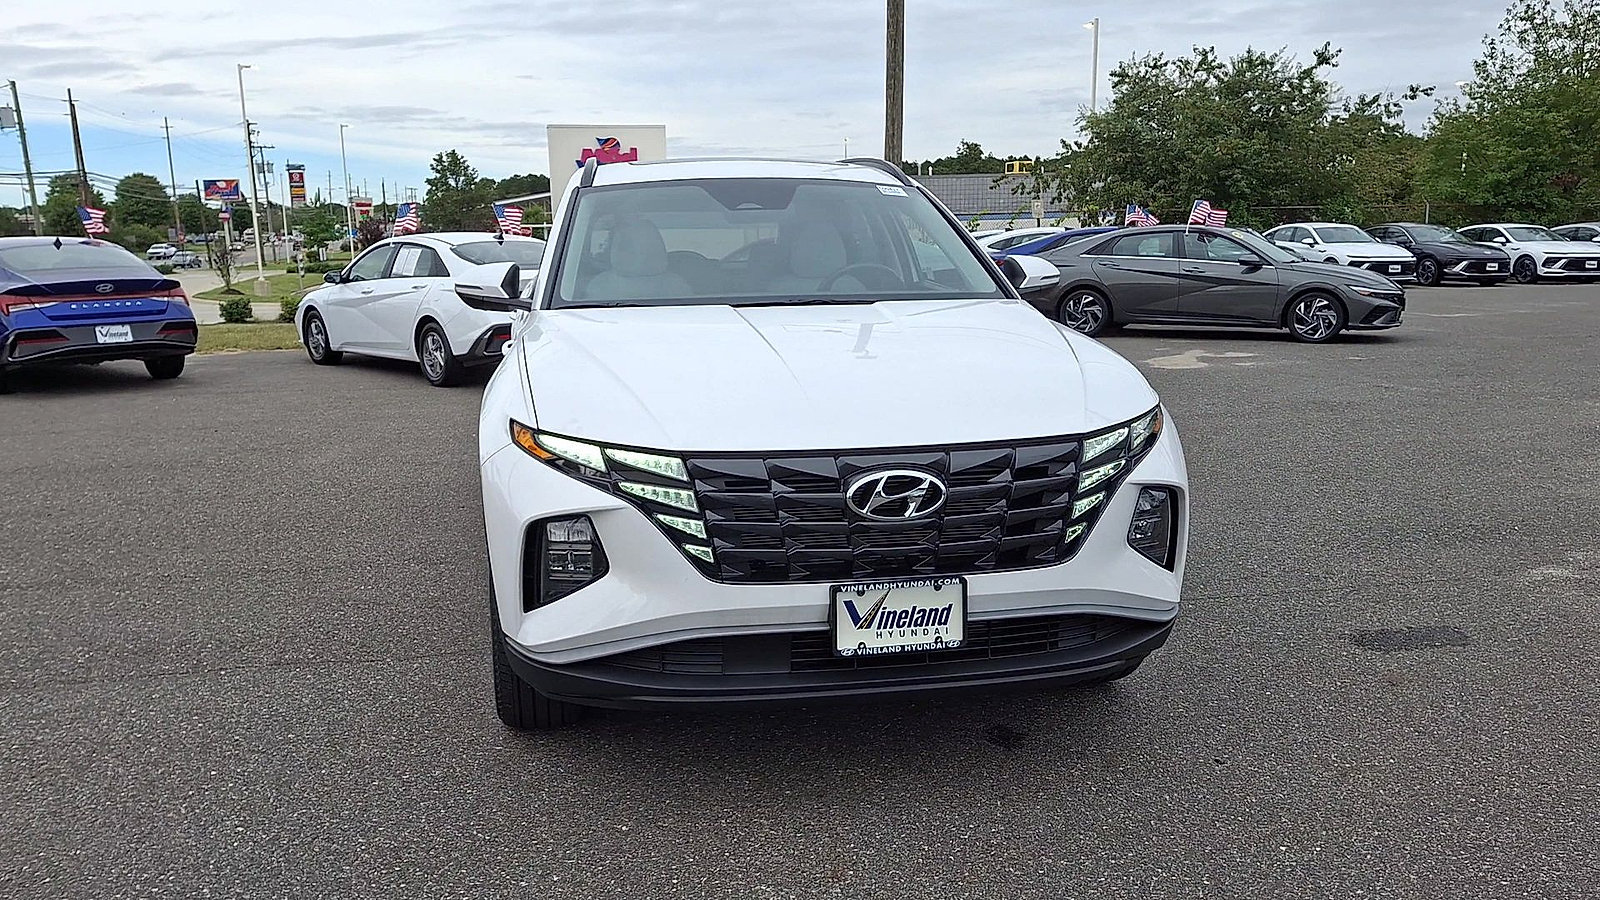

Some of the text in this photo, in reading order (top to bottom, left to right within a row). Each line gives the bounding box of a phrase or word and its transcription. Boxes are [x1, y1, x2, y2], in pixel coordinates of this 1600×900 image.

[840, 577, 960, 593] VINELANDHYUNDAI.COM
[843, 588, 953, 630] Vineland
[876, 627, 949, 639] HYUNDAI
[856, 643, 946, 655] VINELAND HYUNDAI
